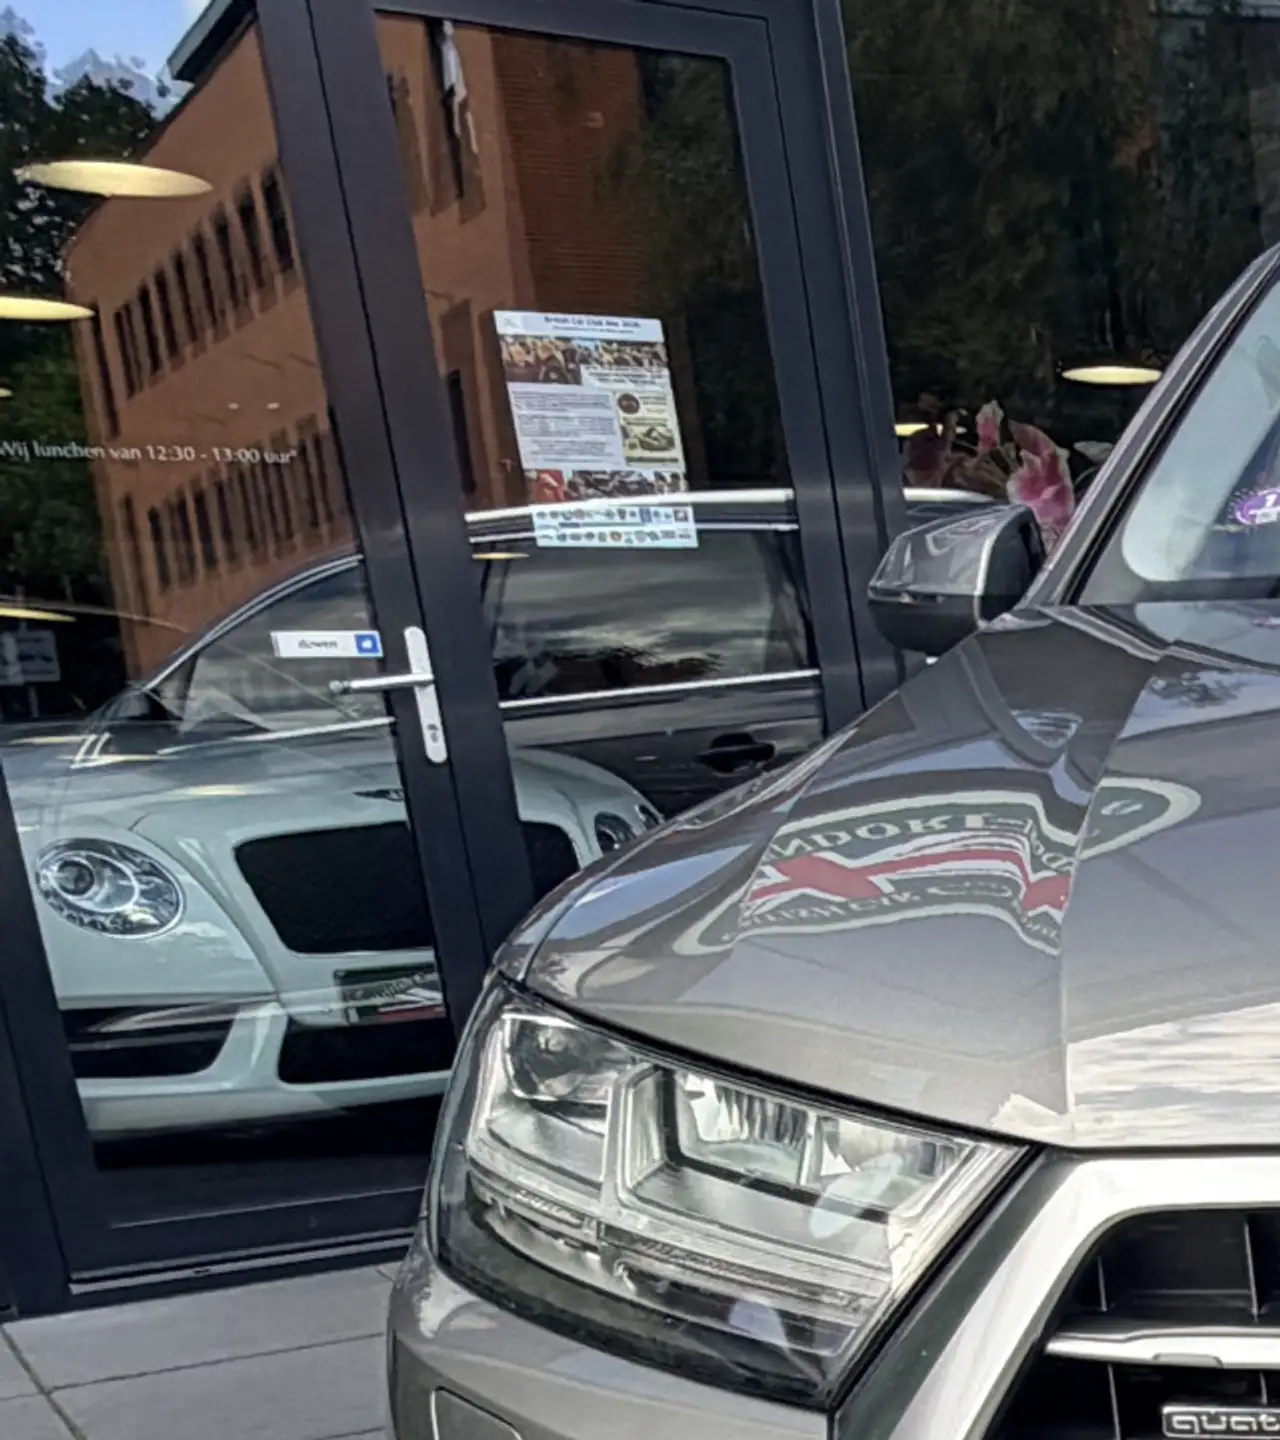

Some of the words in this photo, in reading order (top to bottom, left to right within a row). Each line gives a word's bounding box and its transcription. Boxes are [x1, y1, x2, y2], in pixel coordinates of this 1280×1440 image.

[33, 440, 105, 459] lunchen
[110, 449, 141, 461] van
[147, 445, 195, 461] 12:30
[213, 447, 260, 462] 13:00
